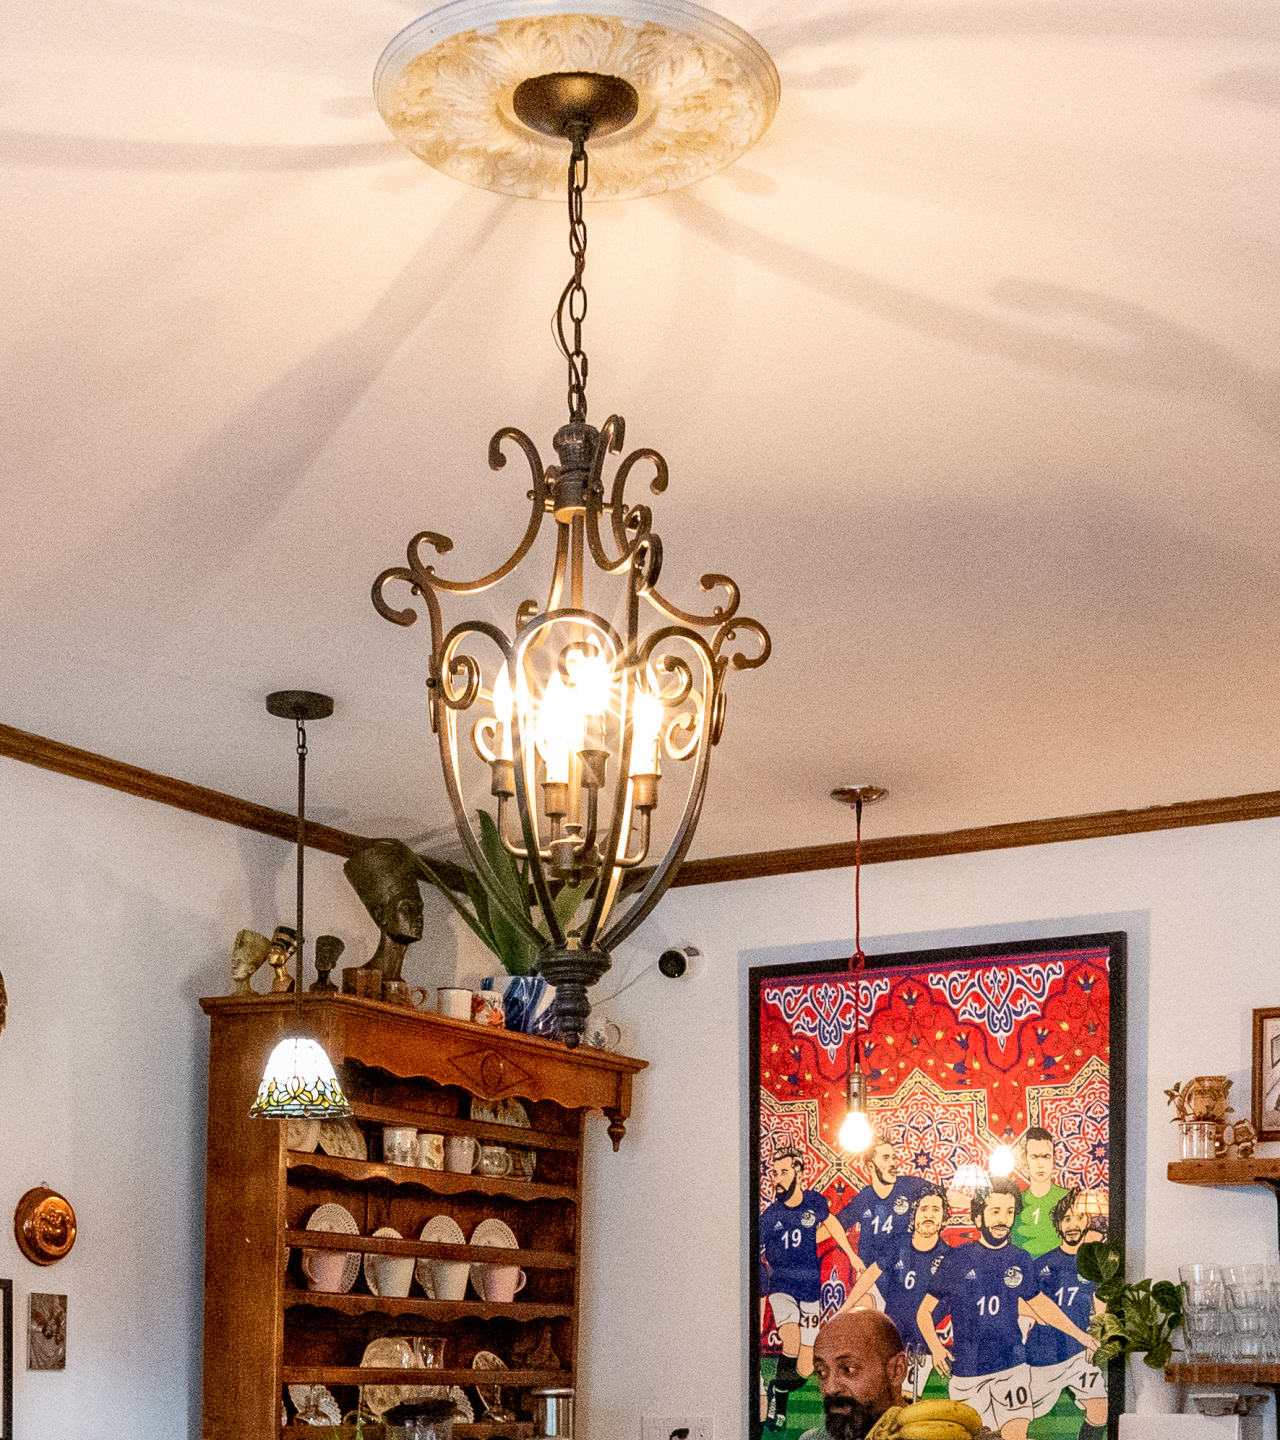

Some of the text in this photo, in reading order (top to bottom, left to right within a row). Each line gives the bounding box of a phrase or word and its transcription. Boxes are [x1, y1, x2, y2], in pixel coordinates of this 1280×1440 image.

[871, 1214, 894, 1235] 14
[1031, 1207, 1041, 1225] 1
[781, 1228, 802, 1250] 19
[904, 1270, 917, 1290] 6
[976, 1295, 1000, 1316] 10
[1054, 1286, 1080, 1307] 17
[803, 1314, 819, 1329] 19
[1079, 1371, 1100, 1389] 17
[1004, 1385, 1028, 1409] 10
